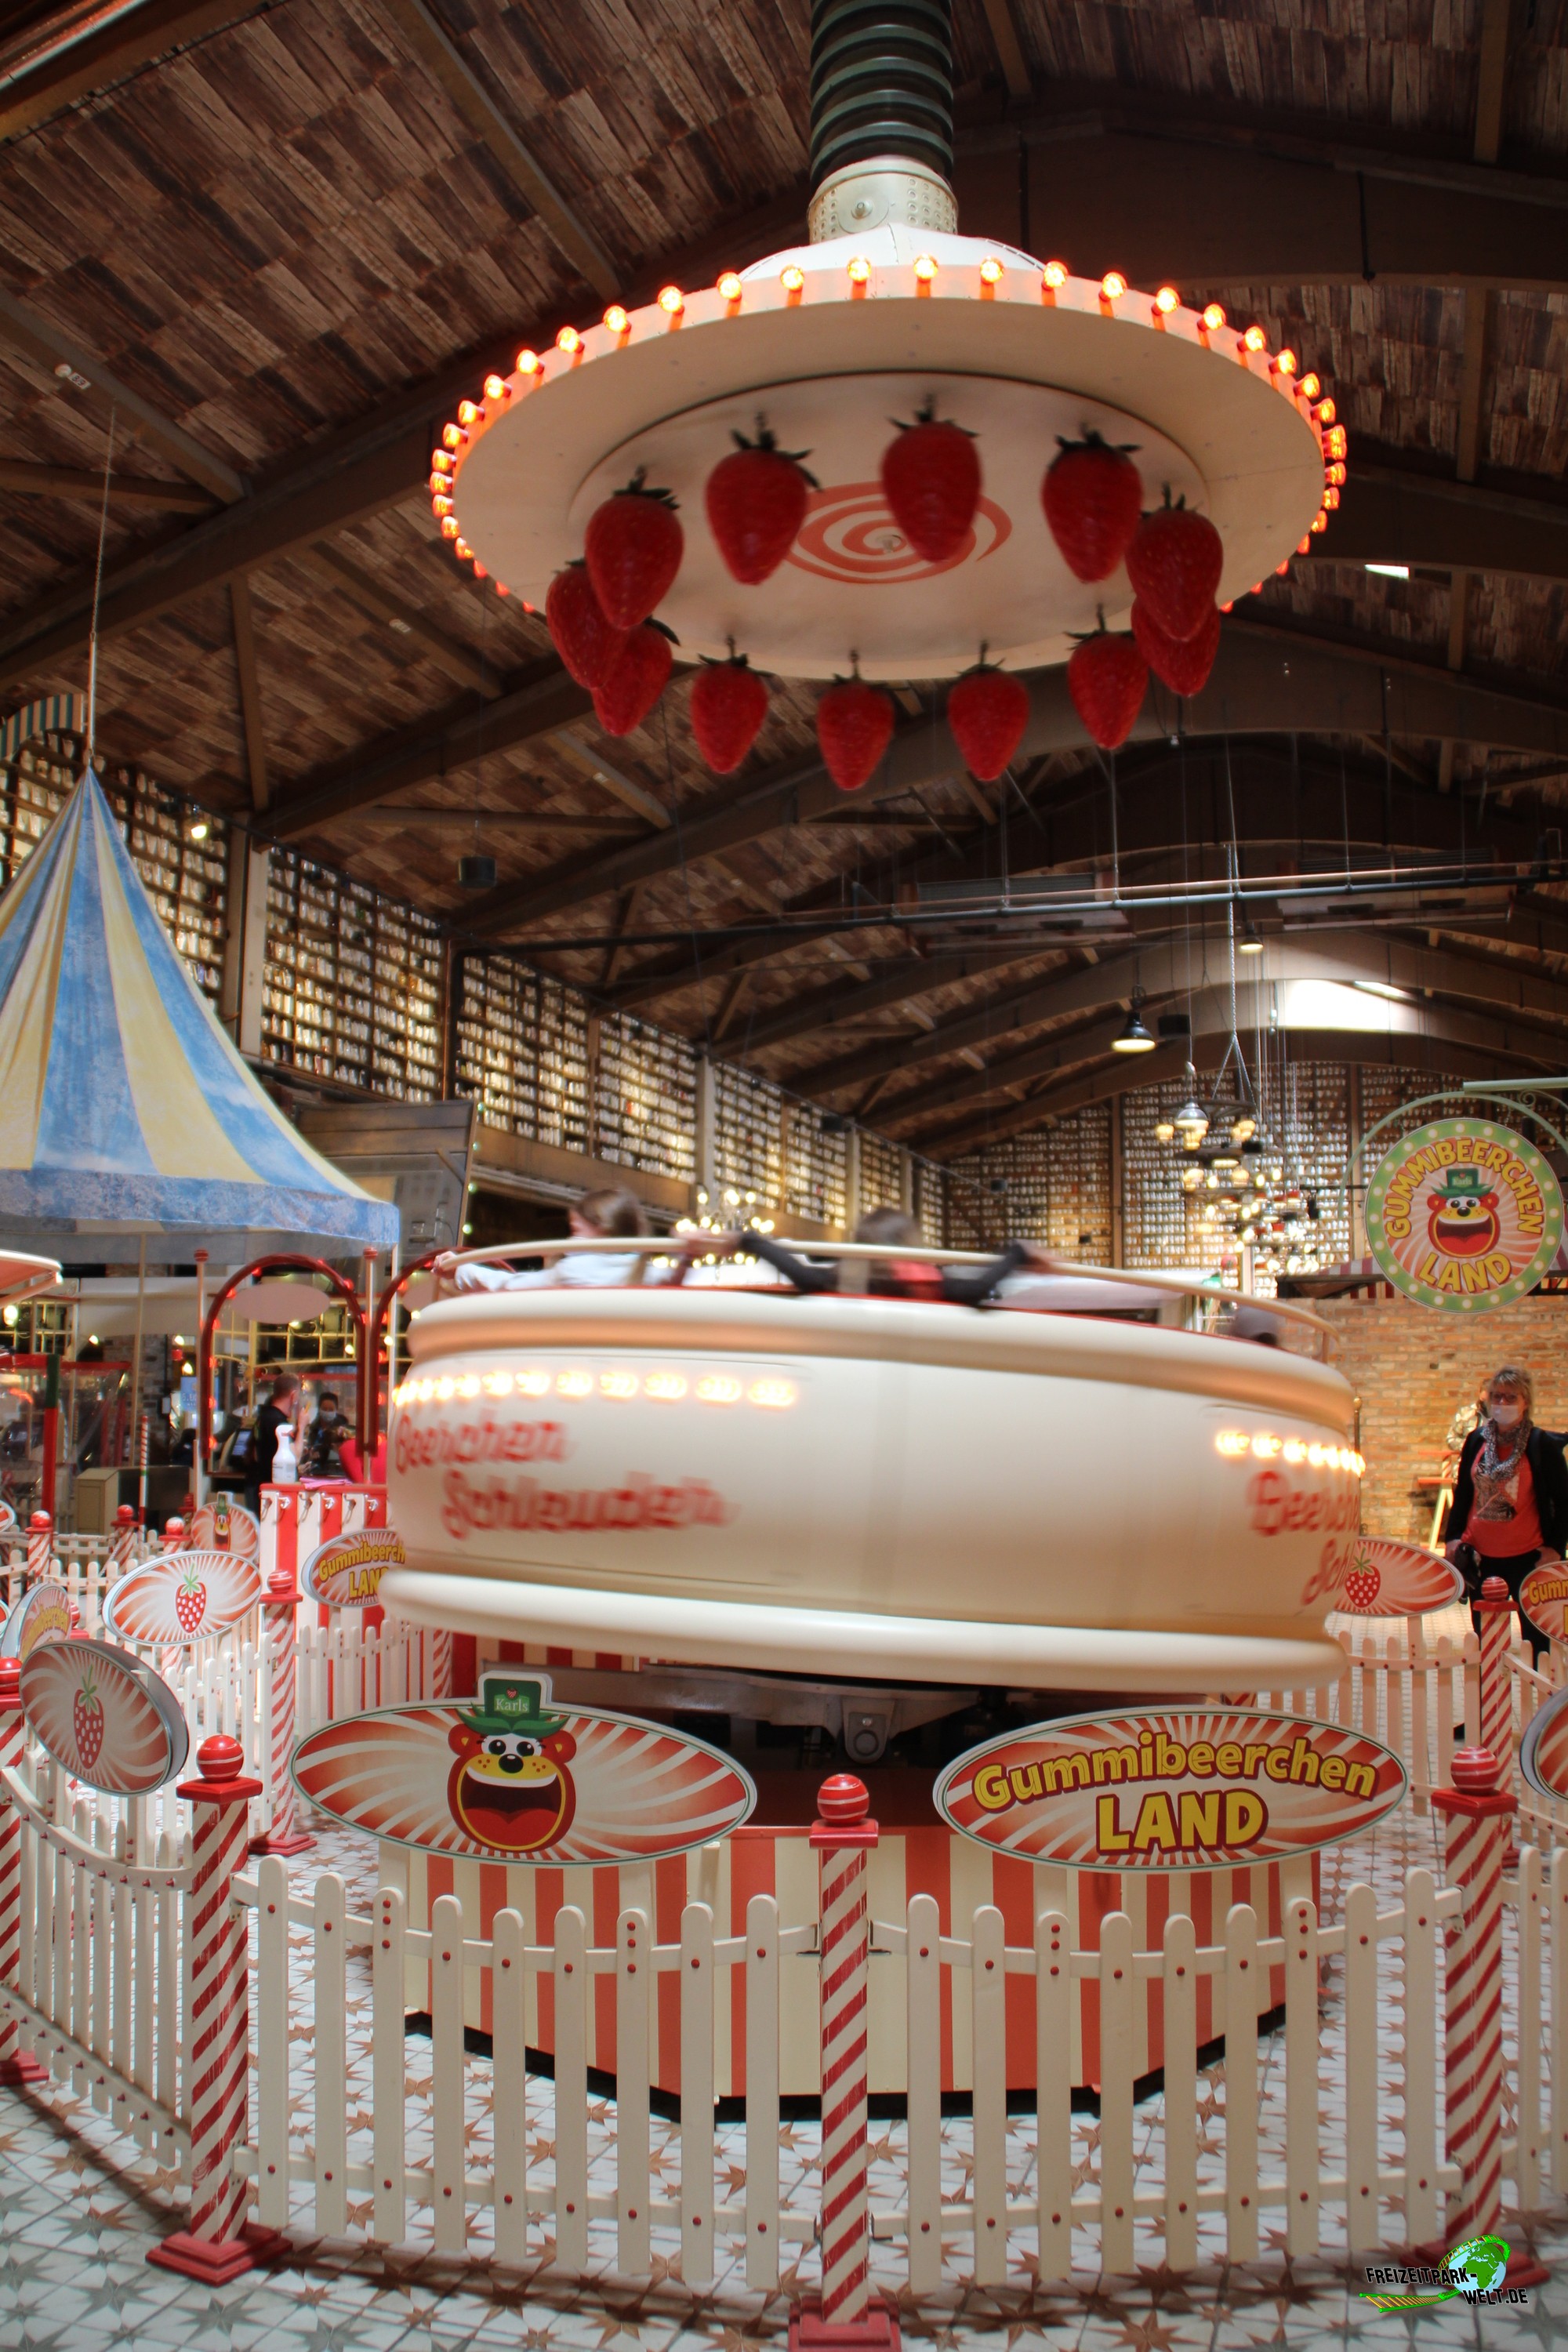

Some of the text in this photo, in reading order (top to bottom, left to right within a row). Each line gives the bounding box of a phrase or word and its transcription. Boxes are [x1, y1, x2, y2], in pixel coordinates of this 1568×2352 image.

[1385, 1139, 1544, 1239] GUMMIBEERCHEN
[1418, 1252, 1512, 1294] LAND
[318, 1541, 406, 1582] Gummibeerch
[348, 1566, 389, 1600] LAN
[495, 1698, 529, 1712] Karls
[972, 1731, 1379, 1814] Gummibeerchen
[1097, 1788, 1269, 1855] LAND
